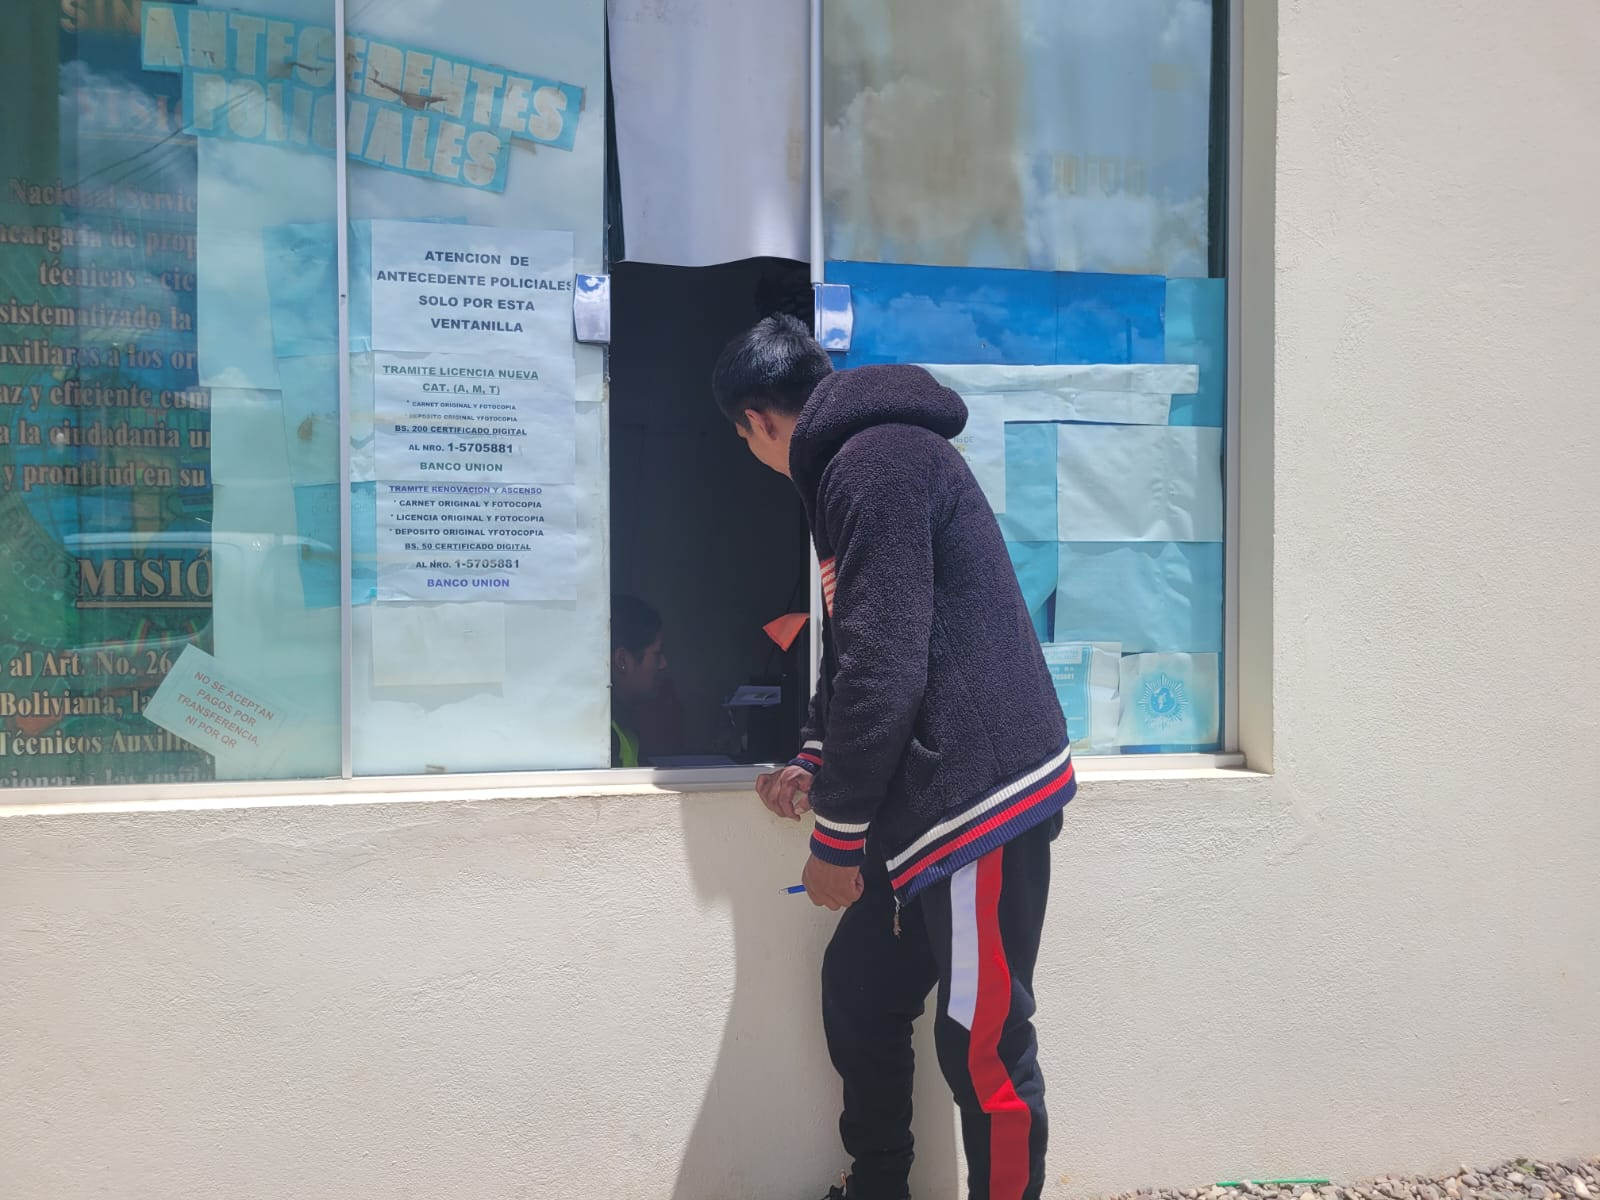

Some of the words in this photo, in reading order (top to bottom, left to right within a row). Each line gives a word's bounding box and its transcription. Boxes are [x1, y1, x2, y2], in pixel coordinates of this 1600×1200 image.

[193, 71, 502, 187] POLICIALES
[424, 250, 501, 265] ATENCION
[510, 255, 529, 267] DE
[39, 259, 136, 289] técnicas
[377, 270, 486, 287] ANTECEDENTE
[490, 276, 572, 291] POLICIALES
[419, 295, 458, 307] SOLO
[463, 297, 493, 309] POR
[498, 299, 535, 311] ESTA
[170, 305, 192, 330] la
[431, 317, 523, 333] VENTANILLA
[383, 365, 436, 376] TRAMITE
[440, 367, 495, 378] LICENCIA
[498, 370, 539, 380] NUEVA
[29, 385, 42, 411] y
[51, 380, 152, 408] eficiente
[422, 383, 450, 393] CAT.
[18, 419, 41, 444] la
[395, 424, 410, 432] BS.
[412, 425, 428, 433] 200
[430, 426, 490, 435] CERTIFICADO
[492, 428, 527, 436] DIGITAL
[422, 444, 445, 452] NRO.
[447, 442, 513, 454] 1-5705881
[419, 461, 461, 471] BANCO
[465, 462, 503, 472] UNION
[3, 464, 16, 491] y
[23, 460, 136, 492] prontitud
[143, 468, 172, 487] en
[180, 468, 207, 487] su
[389, 485, 430, 493] TRAMITE
[432, 486, 490, 494] RENOVACION
[501, 487, 542, 495] ASCENSO
[399, 499, 436, 507] CARNET
[438, 500, 480, 508] ORIGINAL
[492, 501, 542, 509] FOTOCOPIA
[396, 514, 438, 522] LICENCIA
[441, 514, 483, 522] ORIGINAL
[495, 515, 544, 523] FOTOCOPIA
[395, 528, 440, 536] DEPOSITO
[443, 528, 485, 536] ORIGINAL
[405, 542, 420, 550] BS.
[435, 543, 494, 551] CERTIFICADO
[496, 543, 531, 551] DIGITAL
[416, 561, 427, 569] AL
[429, 560, 451, 569] NRO.
[454, 559, 520, 569] 1-5705881
[79, 550, 213, 598] MISIÓ
[427, 578, 468, 588] BANCO
[472, 578, 510, 588] UNION
[9, 652, 32, 677] al
[96, 651, 137, 675] No.
[0, 689, 123, 718] Boliviana,
[194, 671, 210, 685] NO
[211, 679, 226, 694] SE
[225, 688, 274, 721] ACEPTAN
[196, 689, 232, 715] PAGOS
[234, 709, 257, 728] POR
[185, 715, 196, 726] NI
[197, 722, 221, 742] POR
[221, 734, 238, 749] QR
[0, 729, 103, 756] Técnicos
